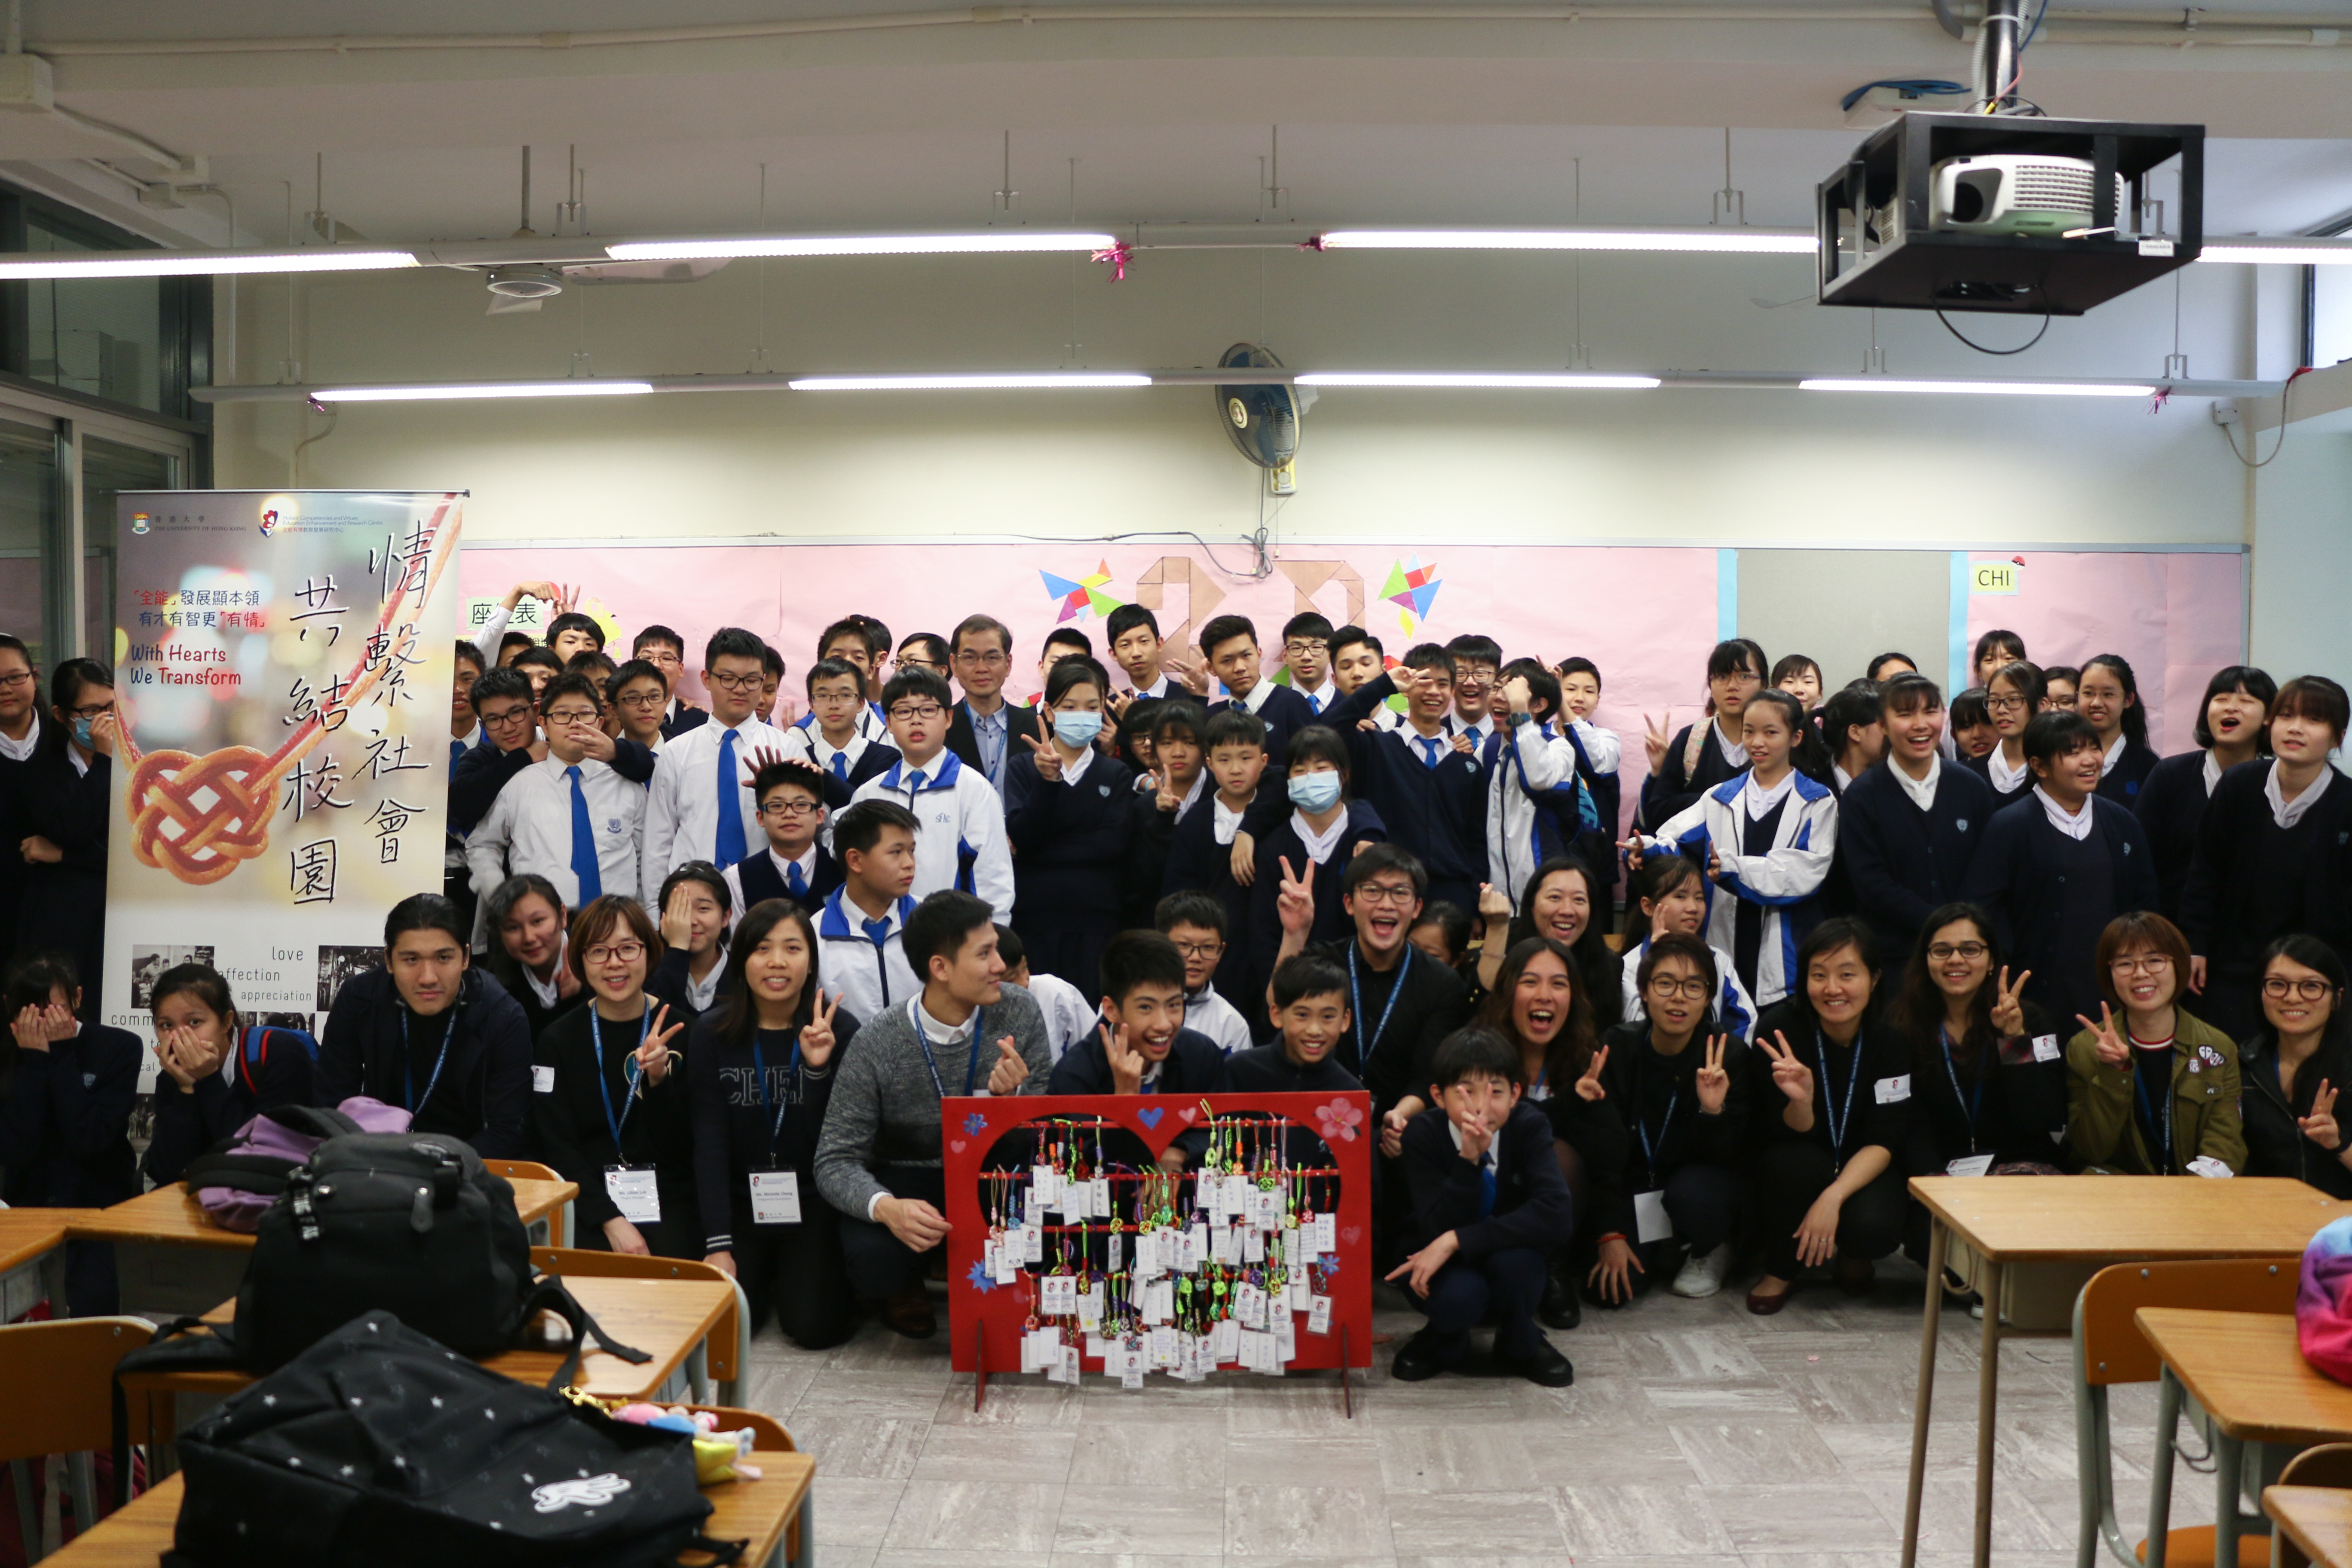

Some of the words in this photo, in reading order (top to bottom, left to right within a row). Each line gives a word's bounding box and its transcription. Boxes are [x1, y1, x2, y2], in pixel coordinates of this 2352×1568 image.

[155, 515, 205, 523] 香港大學
[1978, 570, 2009, 586] CHI
[472, 603, 537, 624] 座表
[131, 644, 163, 662] With
[169, 644, 227, 662] Hearts
[130, 667, 153, 684] We
[158, 667, 242, 685] Transform
[272, 946, 304, 961] love
[241, 990, 312, 1002] appreciation
